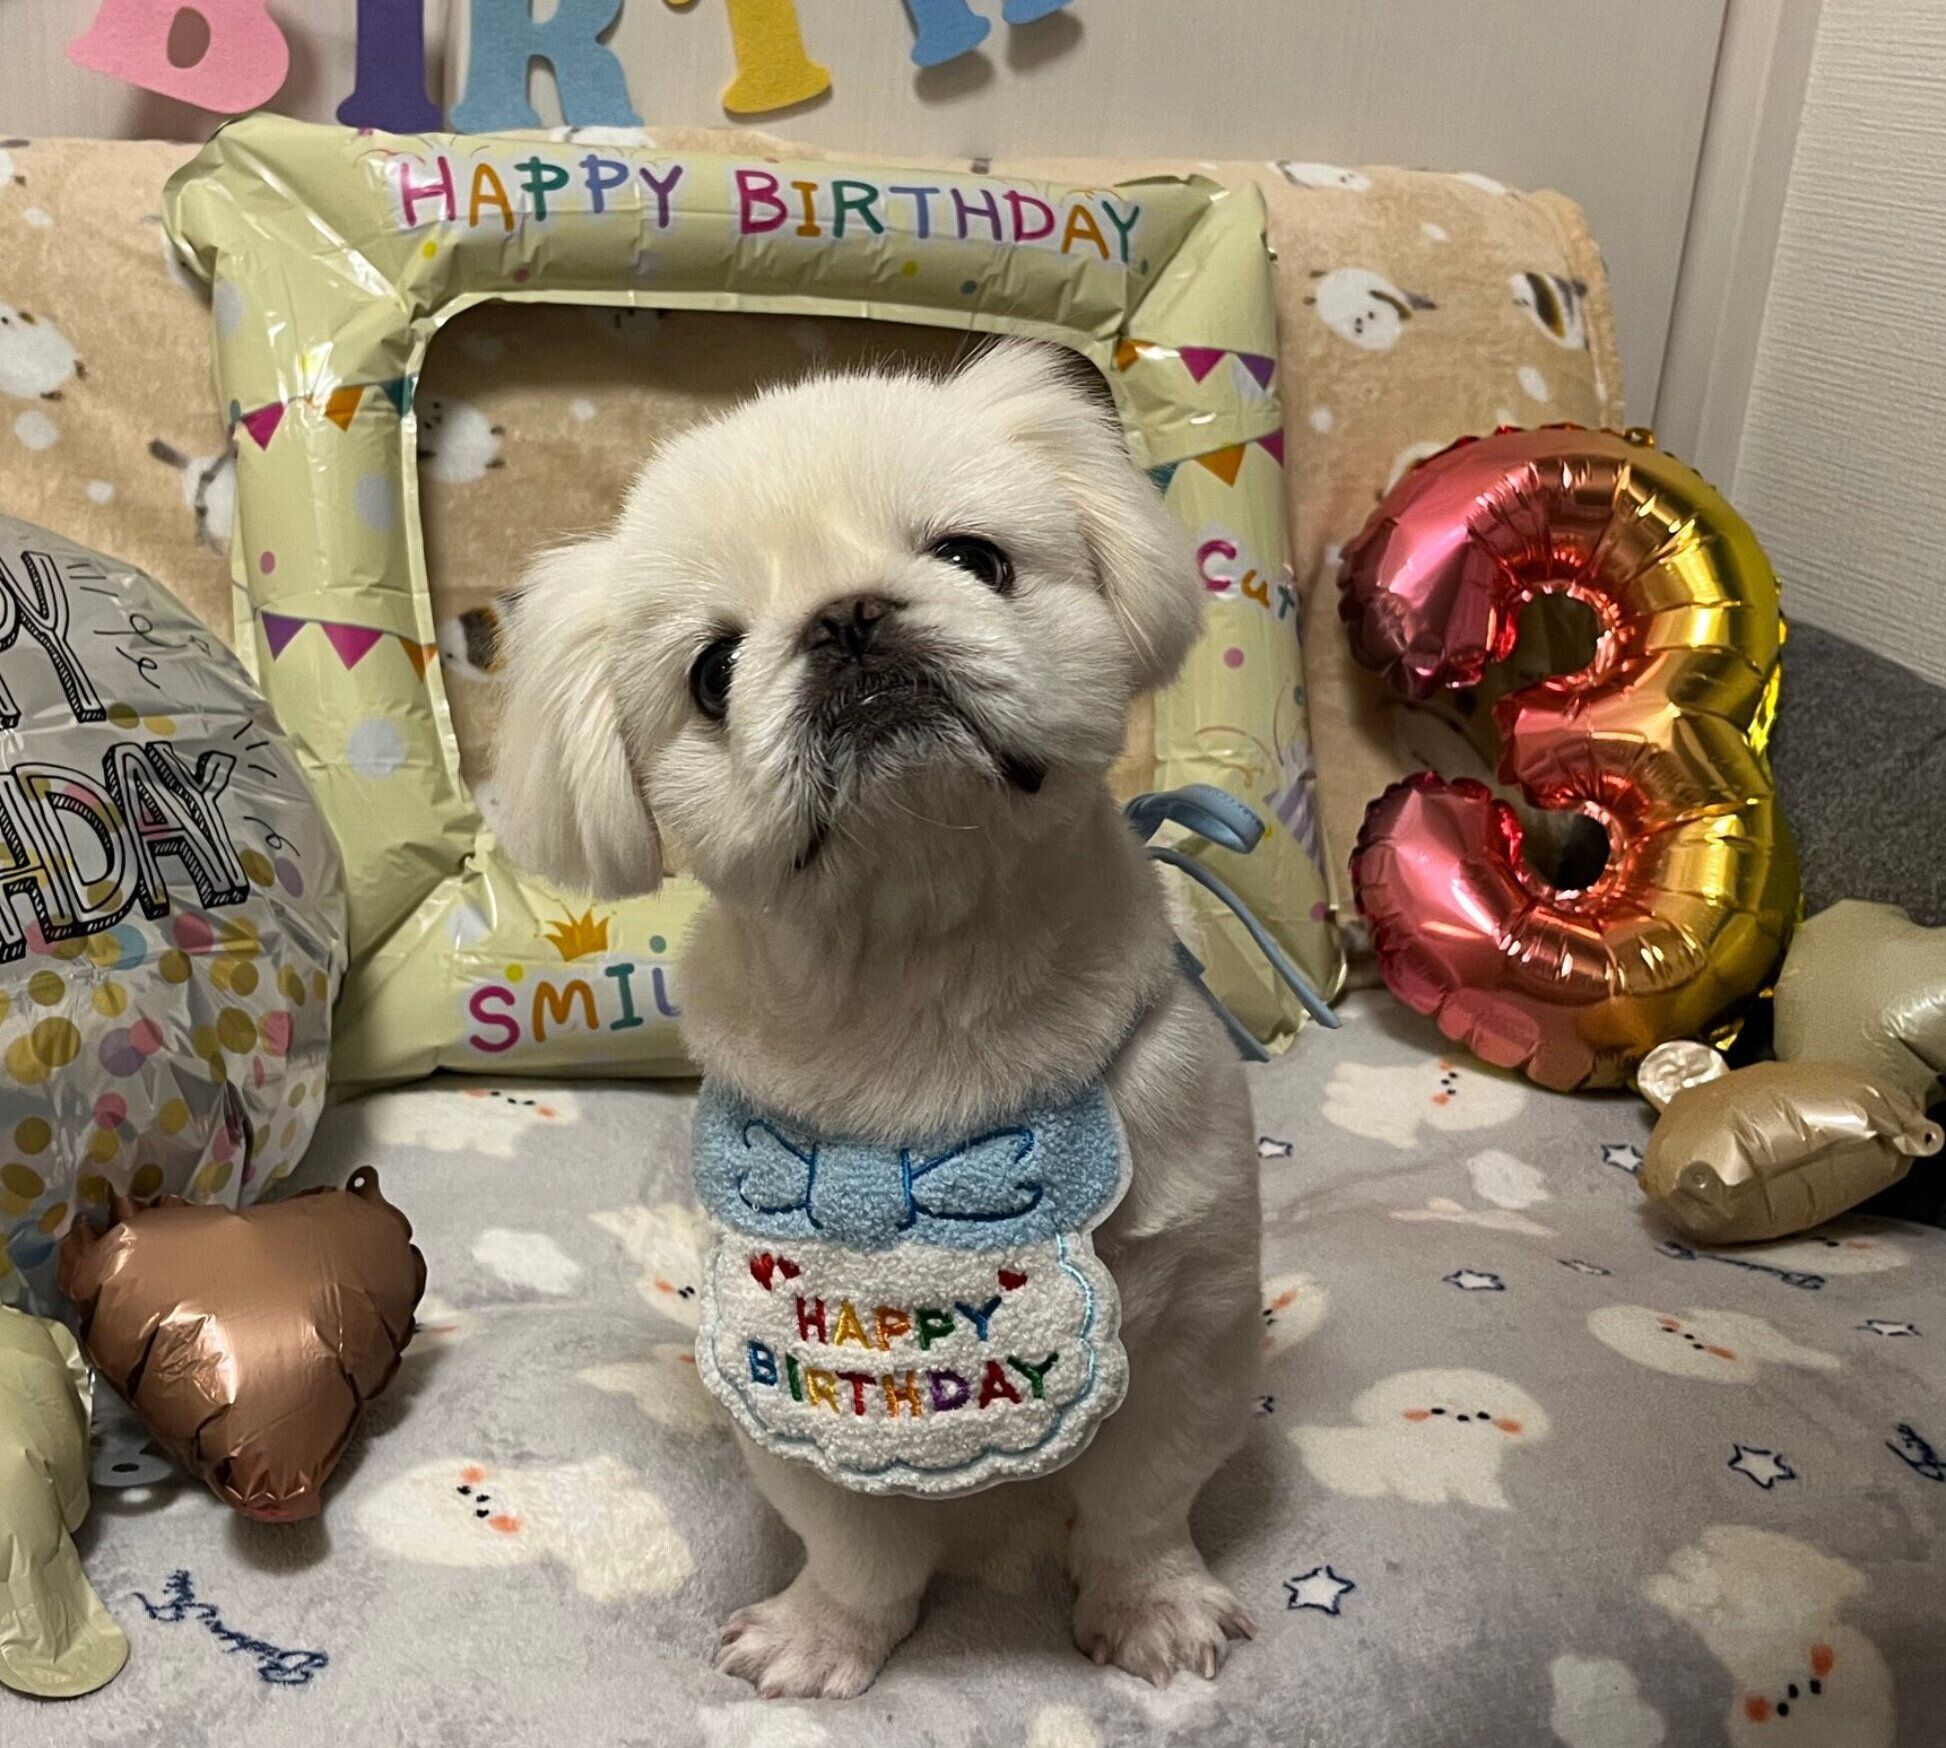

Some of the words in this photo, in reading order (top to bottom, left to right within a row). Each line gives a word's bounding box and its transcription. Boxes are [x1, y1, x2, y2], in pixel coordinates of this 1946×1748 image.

[66, 0, 1074, 133] BIRT
[399, 155, 684, 231] HAPPY
[735, 168, 1141, 263] BIRTHDAY
[796, 1296, 1002, 1352] HAPPY
[748, 1340, 1060, 1418] BIRTHDAY
